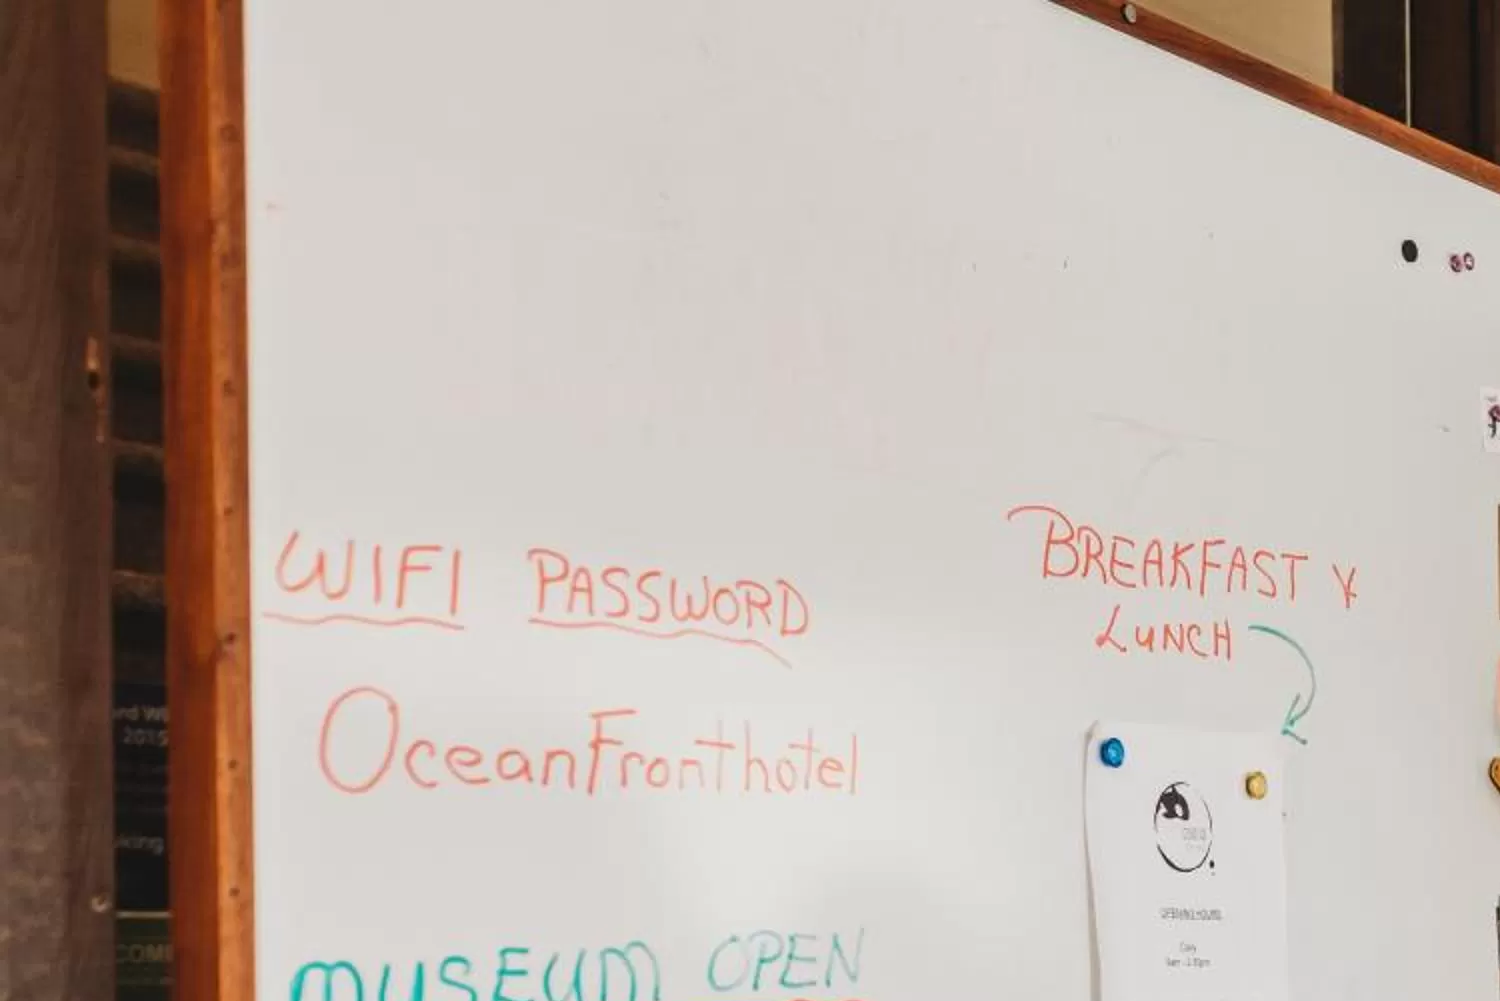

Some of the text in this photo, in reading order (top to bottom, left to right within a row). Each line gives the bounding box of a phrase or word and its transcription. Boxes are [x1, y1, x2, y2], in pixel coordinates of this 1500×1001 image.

[275, 530, 809, 638] WIFI PASSWORD
[1007, 504, 1309, 602] BREAKFAST
[1095, 603, 1233, 662] LUNCH
[705, 929, 866, 993] OPEN
